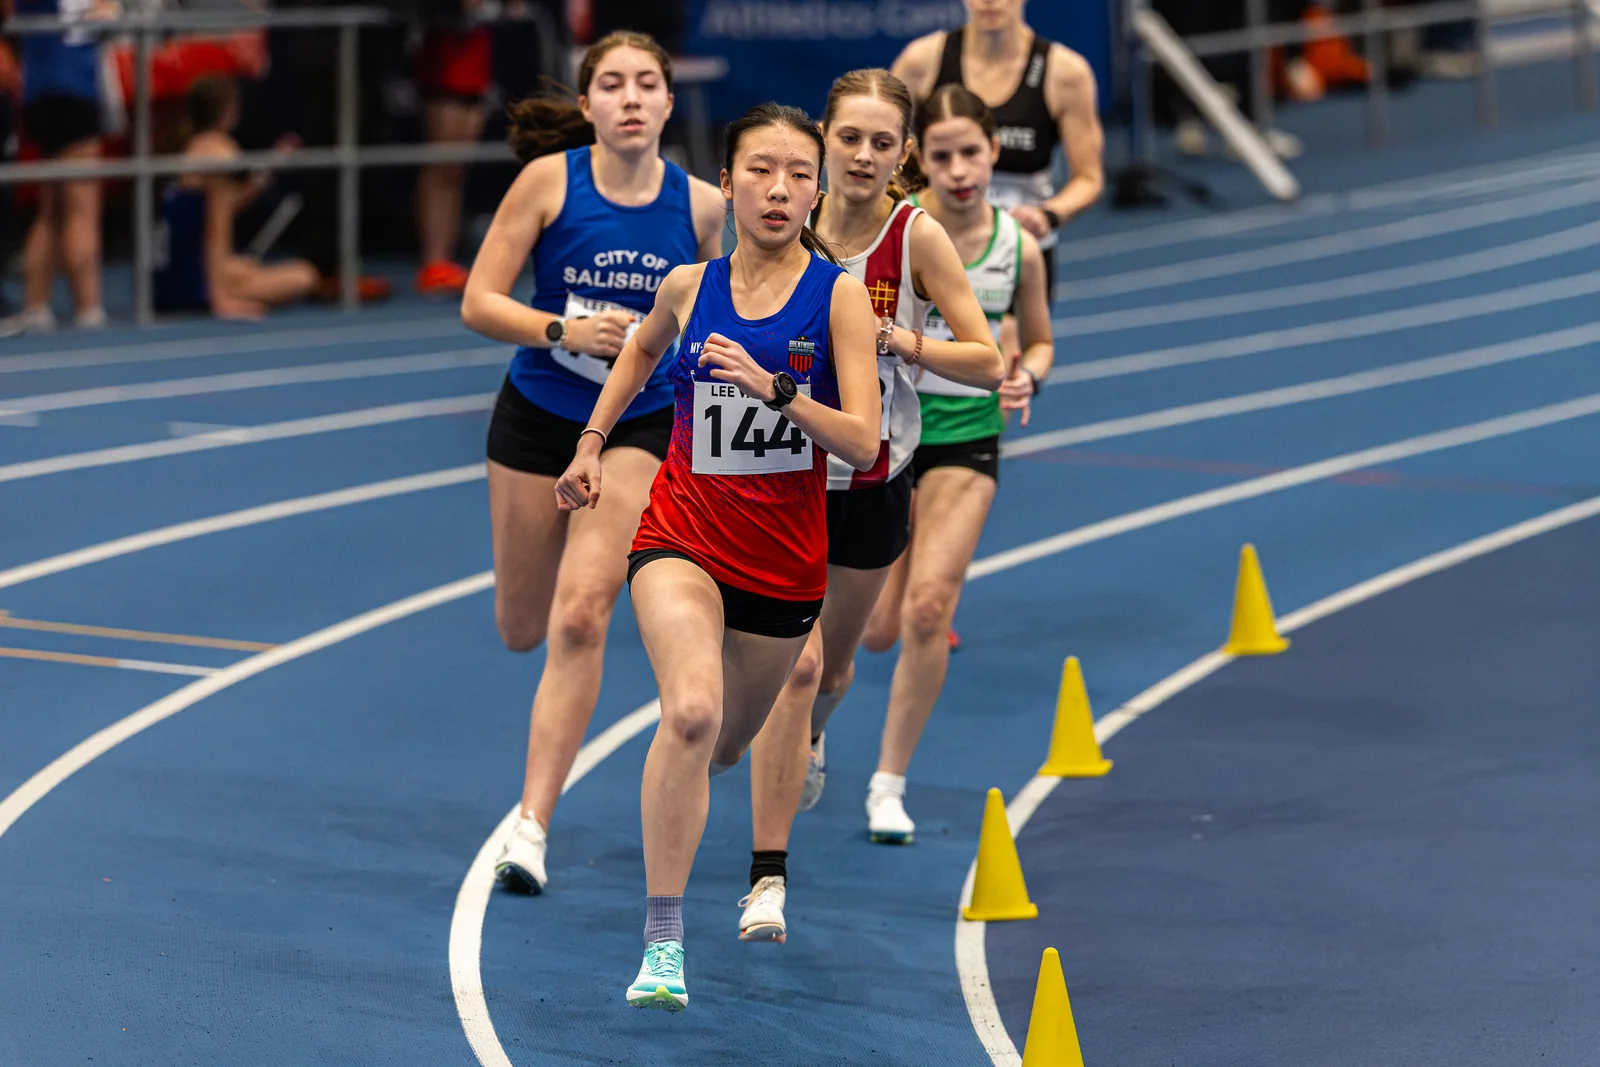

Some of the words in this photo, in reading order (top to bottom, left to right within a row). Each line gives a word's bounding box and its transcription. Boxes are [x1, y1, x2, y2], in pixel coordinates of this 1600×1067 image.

[594, 250, 639, 268] CITY
[641, 253, 669, 271] OF
[563, 266, 665, 293] SALISBU
[711, 385, 735, 398] LEE
[704, 404, 807, 458] 144
